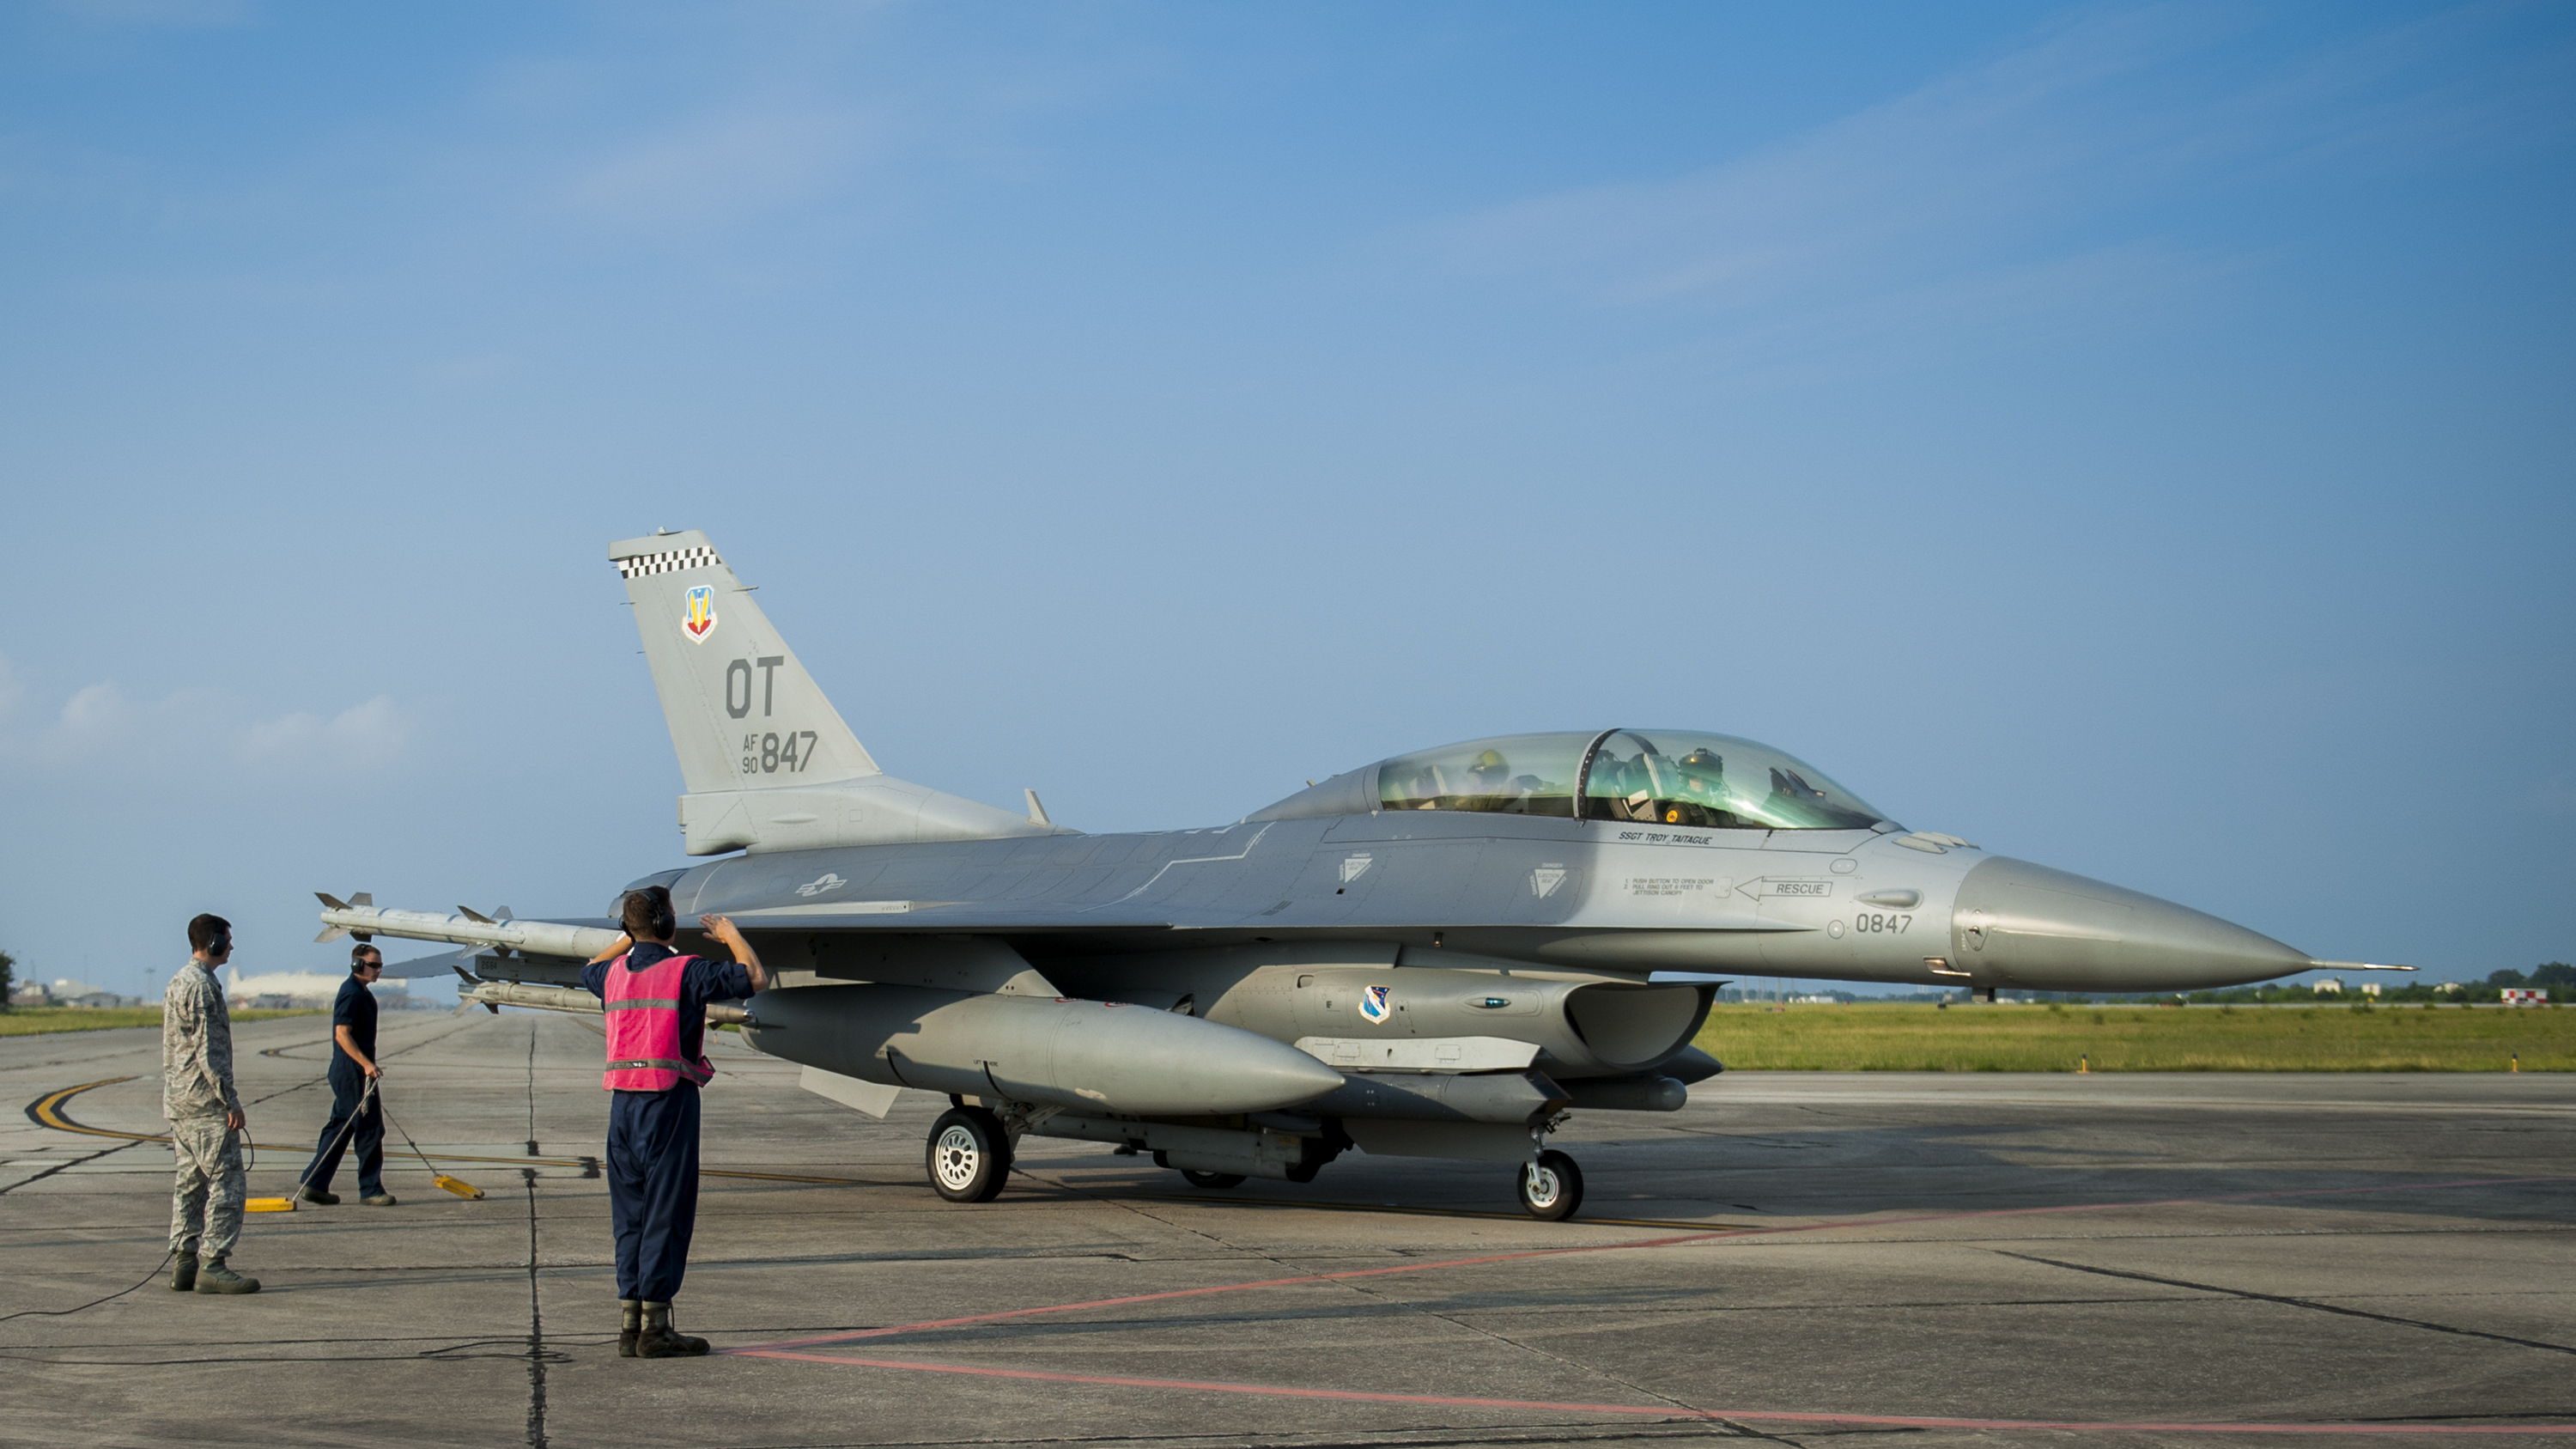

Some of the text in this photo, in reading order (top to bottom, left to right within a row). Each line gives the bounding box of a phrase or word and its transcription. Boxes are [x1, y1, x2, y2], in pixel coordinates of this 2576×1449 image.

[726, 655, 784, 719] OT
[743, 734, 758, 752] AF
[762, 731, 818, 773] 847
[742, 757, 758, 774] 90
[1619, 831, 1713, 845] SSGT TROY TAITAGUE
[1776, 884, 1824, 894] RESCUE
[1856, 913, 1912, 934] 0847
